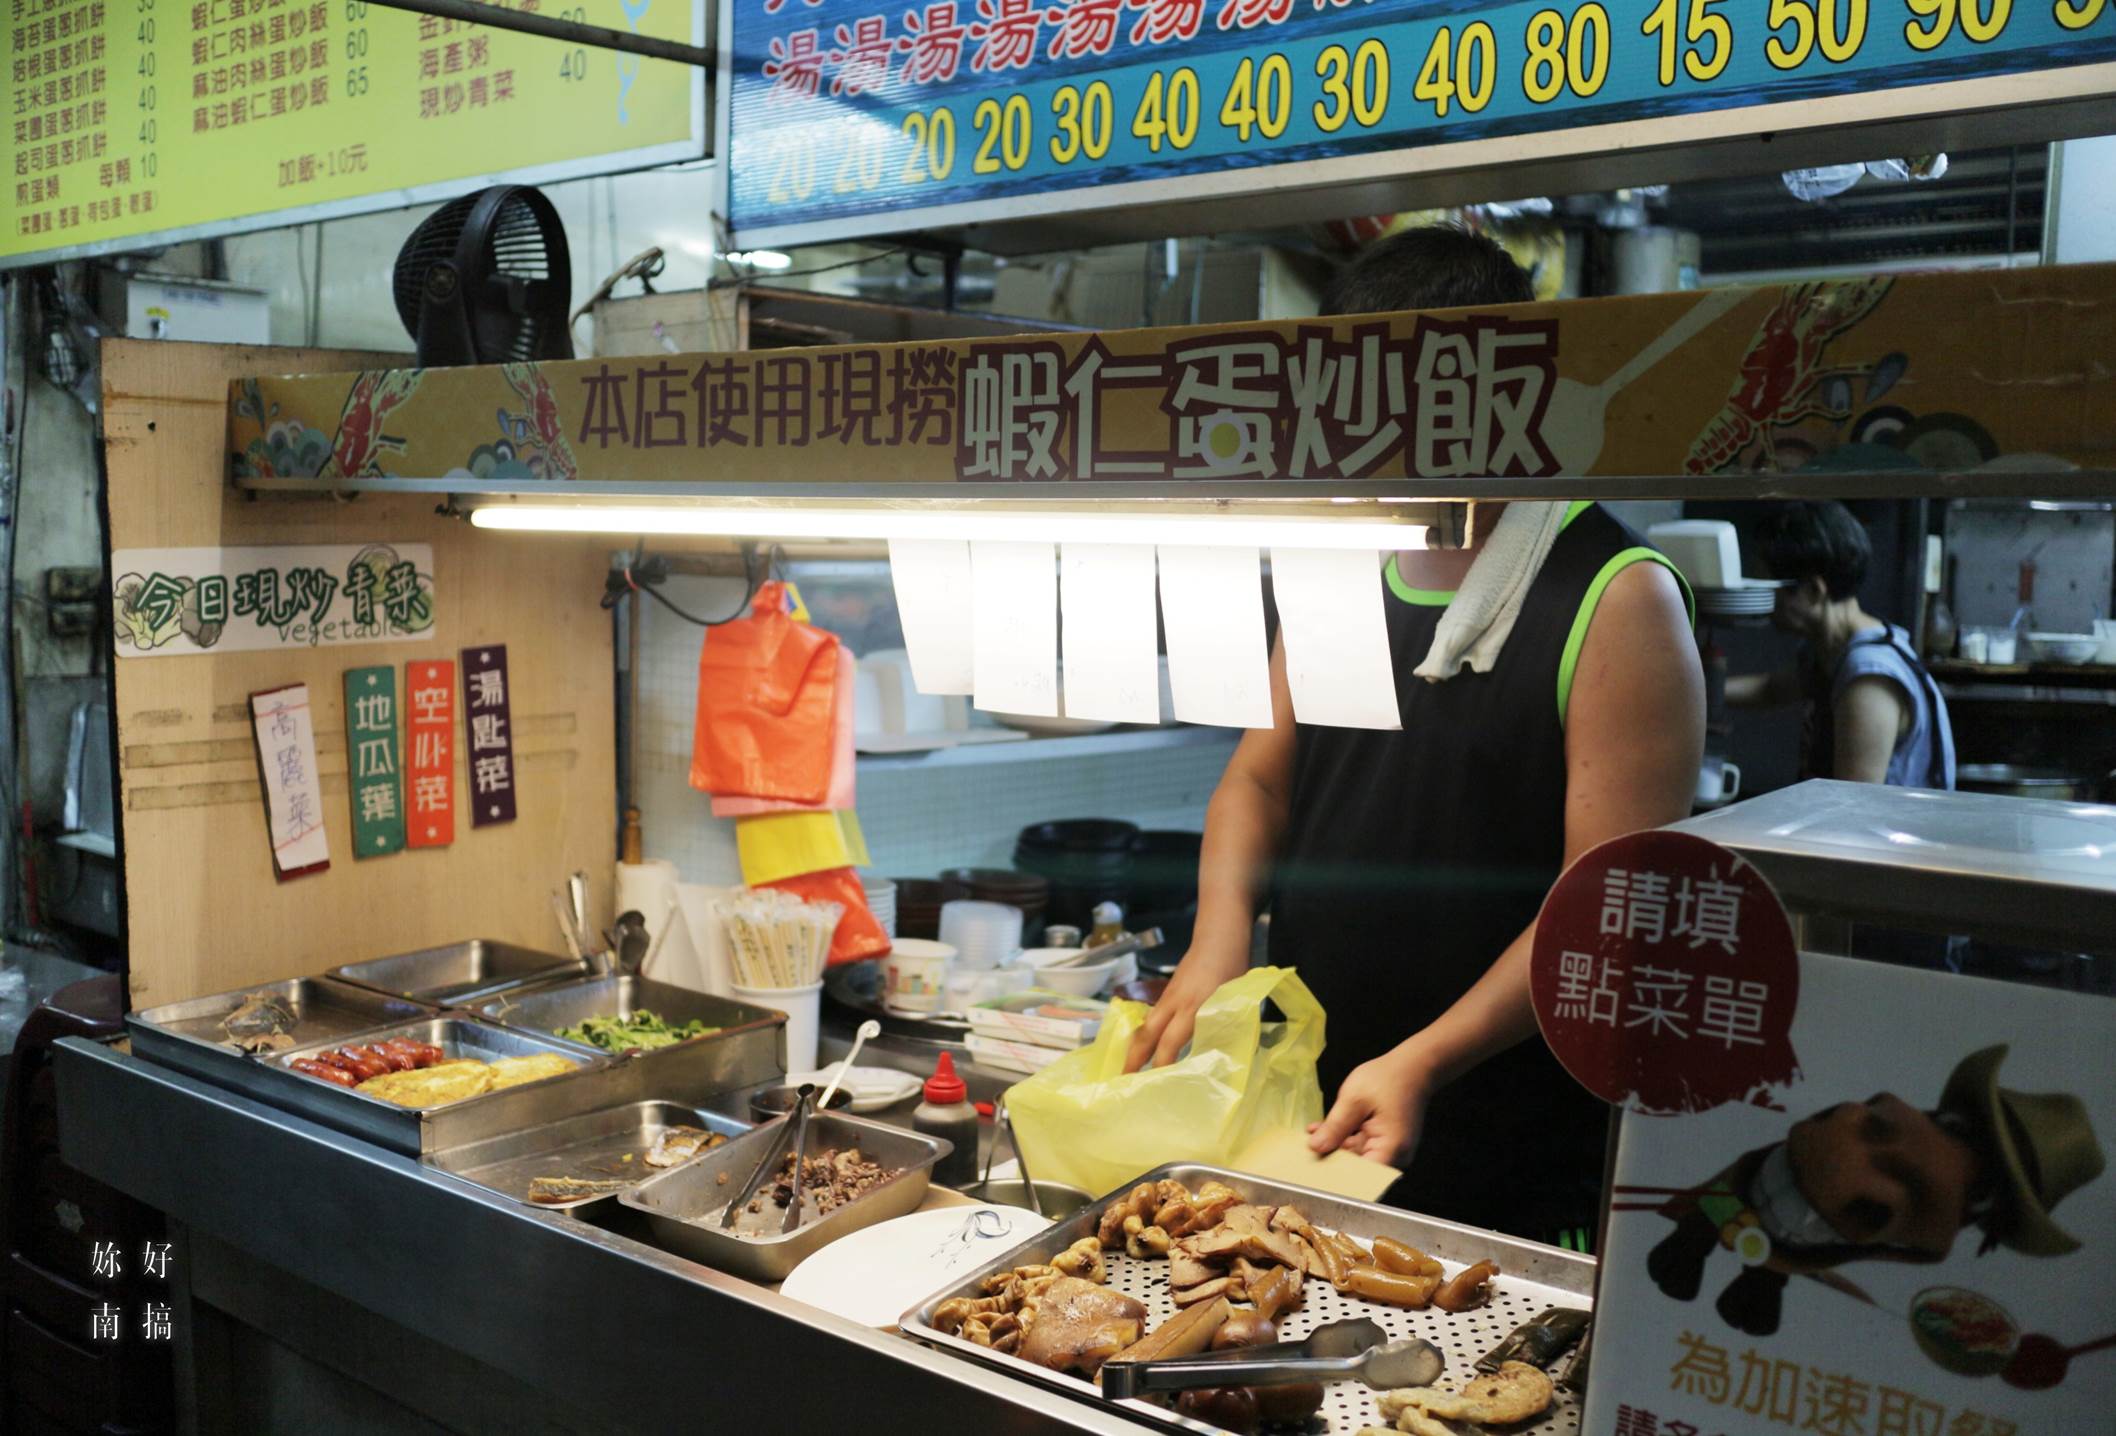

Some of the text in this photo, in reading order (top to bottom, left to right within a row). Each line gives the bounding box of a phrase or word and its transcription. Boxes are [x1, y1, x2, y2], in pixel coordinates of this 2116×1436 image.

[138, 18, 155, 44] 40
[192, 0, 286, 31] 蝦仁蛋炒
[346, 28, 368, 59] 60
[897, 1, 966, 84] 湯
[970, 0, 1042, 72] 湯
[138, 52, 155, 78] 40
[138, 85, 156, 111] 40
[347, 66, 369, 97] 65
[420, 49, 586, 119] 現炒青菜 40
[900, 106, 956, 184] 20
[973, 94, 1033, 174] 20
[1050, 80, 1114, 165] 30
[1131, 67, 1200, 152] 40
[1219, 52, 1293, 143] 40
[1312, 38, 1391, 133] 30
[1413, 20, 1497, 117] 40
[1521, 1, 1610, 104] 80
[1640, 0, 1732, 87] 15
[1764, 0, 1871, 70] 50
[139, 118, 156, 144] 40
[141, 152, 157, 178] 10
[578, 316, 1561, 480] 本店使用現撈 蝦仁蛋炒飯
[136, 562, 430, 631] 今日現炒青菜
[354, 693, 397, 823] 地瓜葉
[413, 687, 449, 813] 空心菜
[470, 669, 511, 794] 湯匙菜
[1599, 868, 1744, 955] 請填
[1554, 950, 1768, 1050] 點菜單
